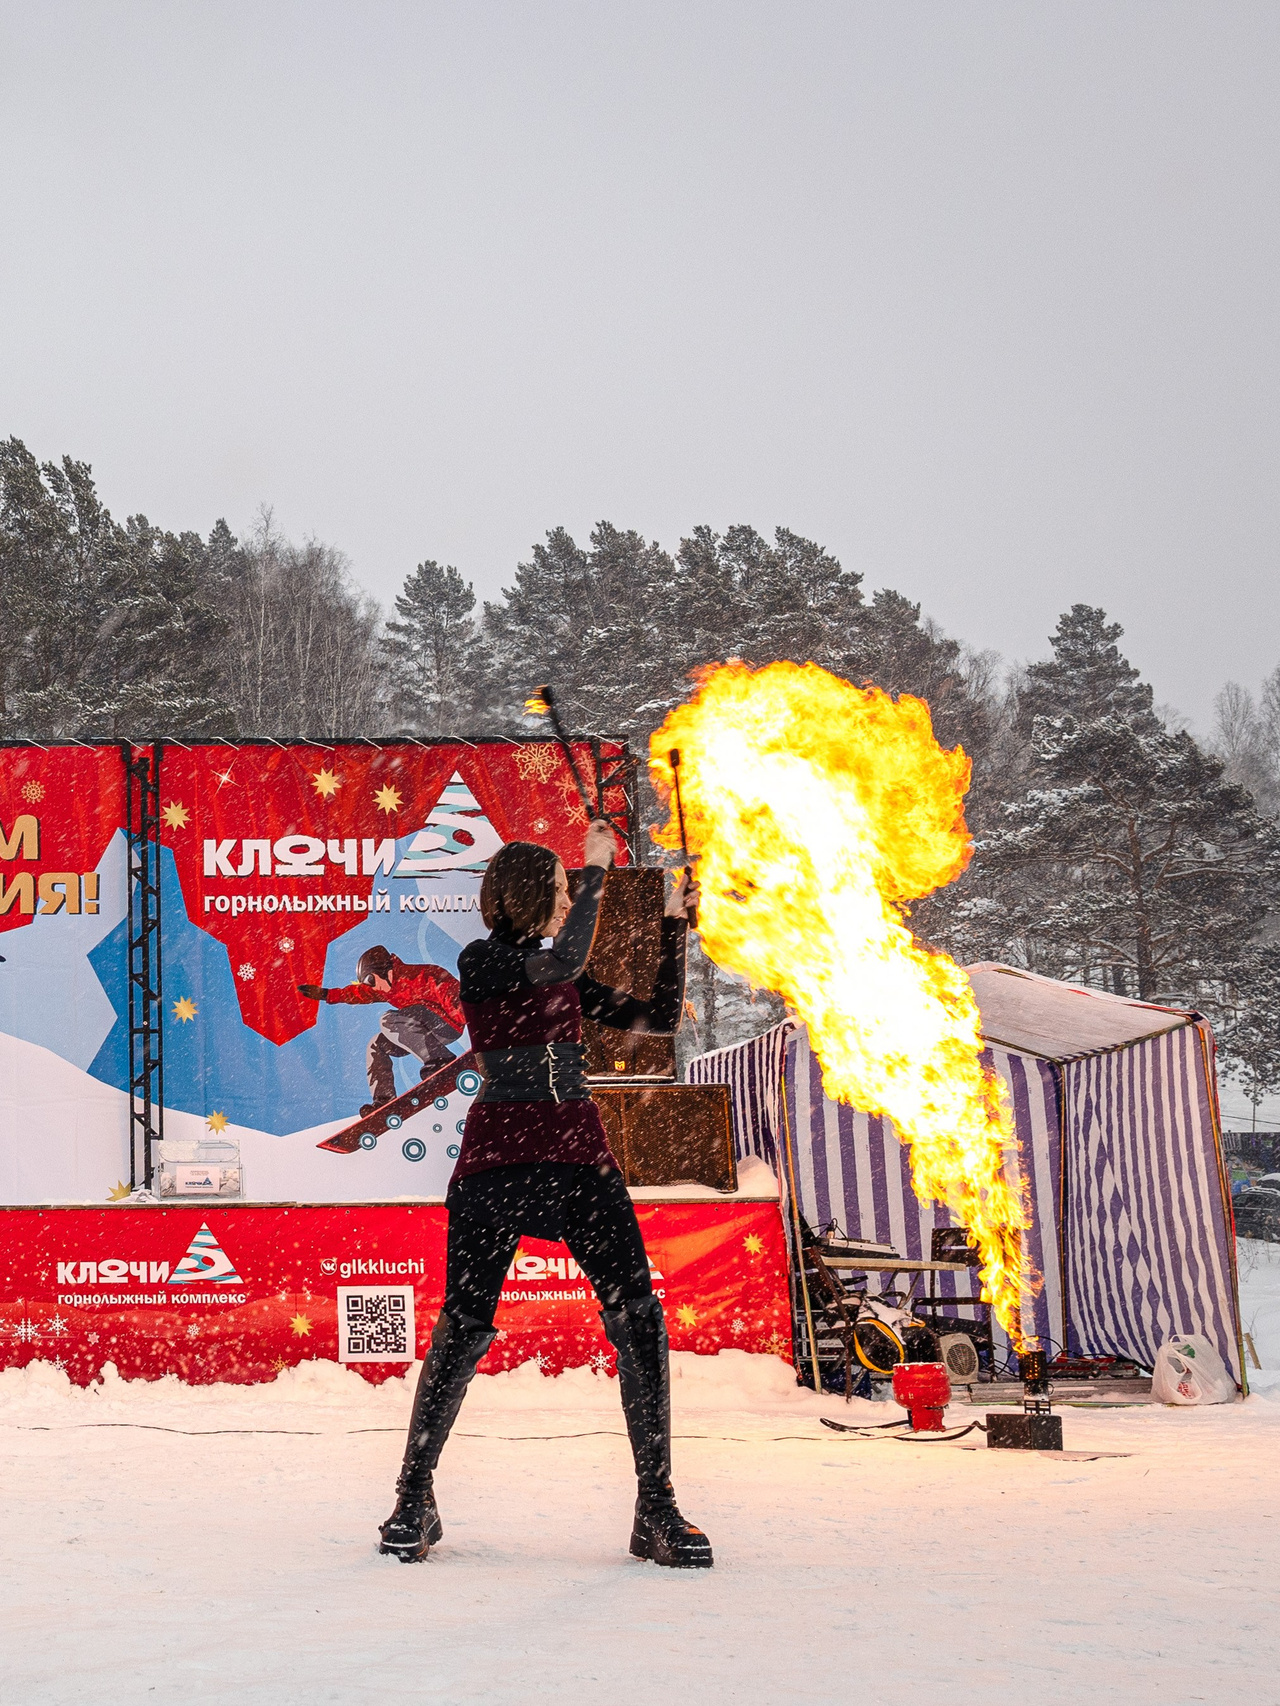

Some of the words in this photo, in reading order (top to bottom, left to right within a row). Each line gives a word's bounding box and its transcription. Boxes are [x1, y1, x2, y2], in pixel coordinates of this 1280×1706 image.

[204, 834, 396, 877] КЛЮЧИ
[204, 888, 391, 917] горнолыжный
[399, 894, 482, 912] компл
[57, 1258, 170, 1284] КЛЮЧИ
[340, 1258, 425, 1279] glkkluchi
[507, 1255, 587, 1281] ЮЧИ
[57, 1290, 167, 1307] горнолыжный
[171, 1292, 246, 1304] комплекс
[500, 1286, 587, 1302] нолыжный
